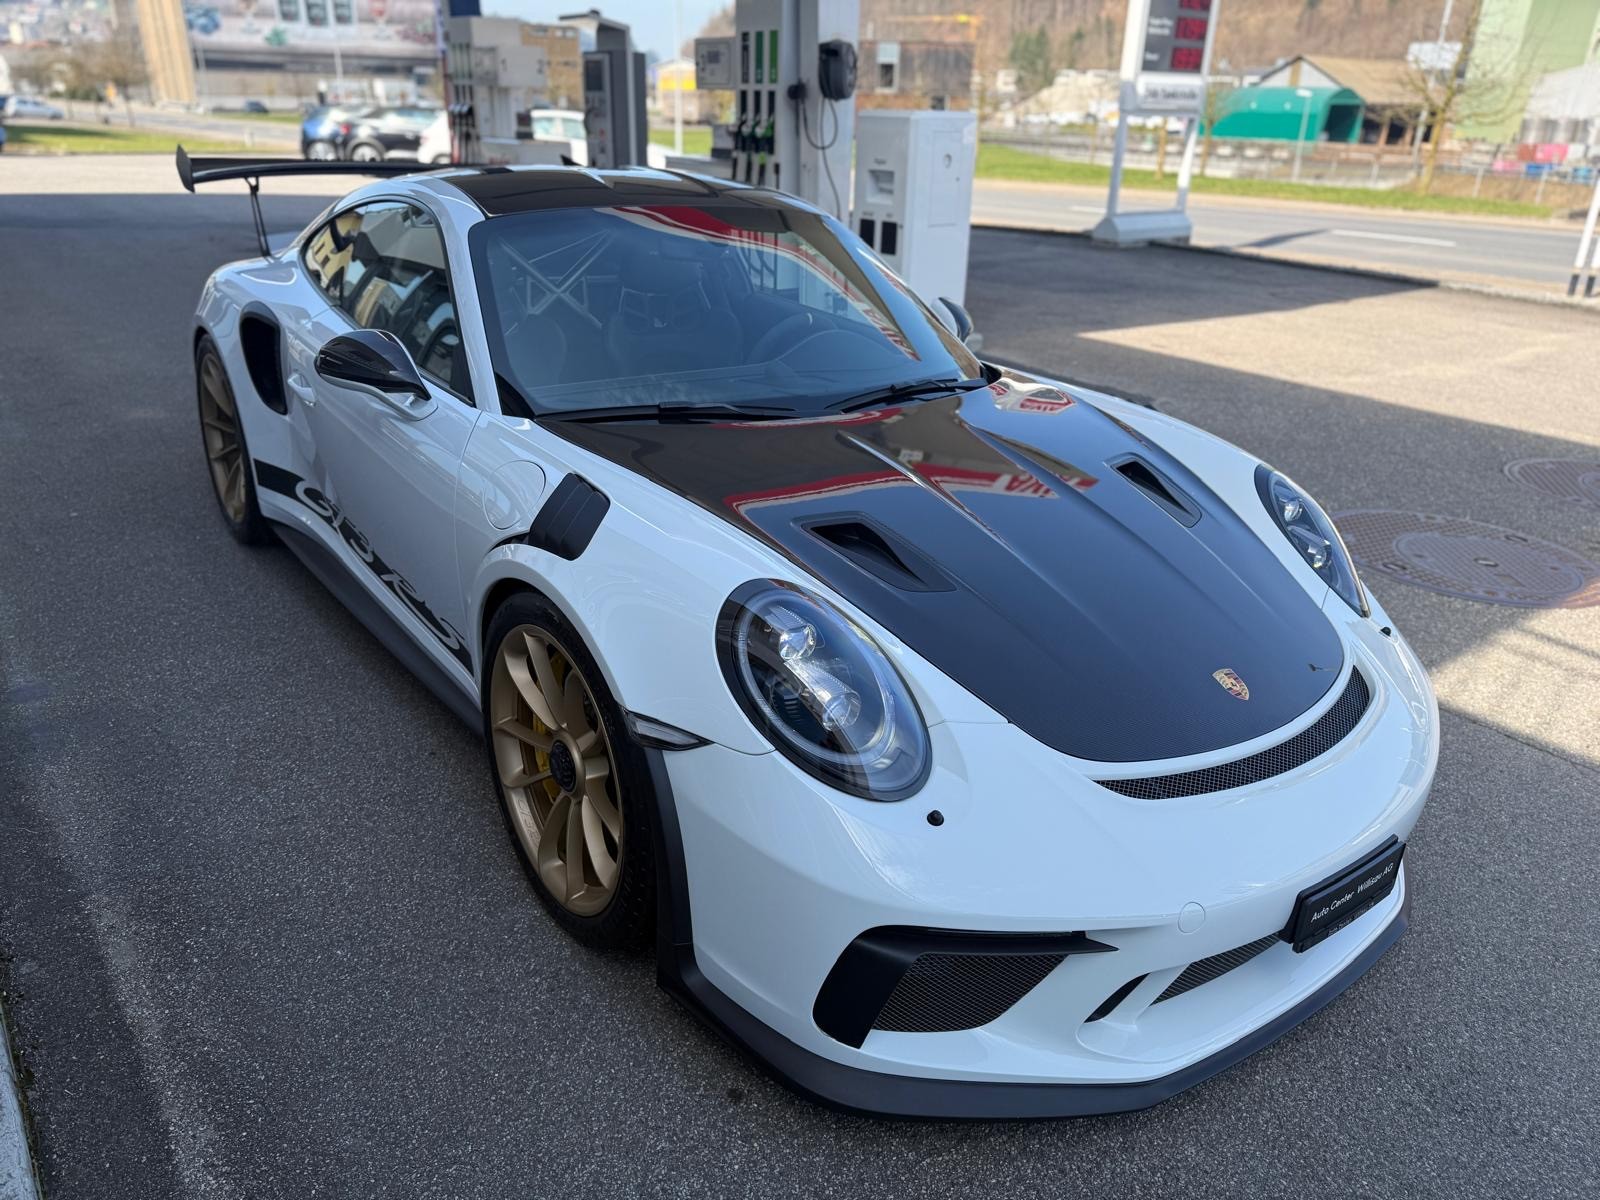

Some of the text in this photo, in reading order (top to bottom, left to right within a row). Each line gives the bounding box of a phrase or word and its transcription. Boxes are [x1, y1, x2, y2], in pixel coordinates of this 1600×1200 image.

[296, 481, 465, 650] GT3 RS
[1311, 907, 1329, 923] Auto
[1331, 891, 1355, 911] Center
[1382, 862, 1395, 876] AG
